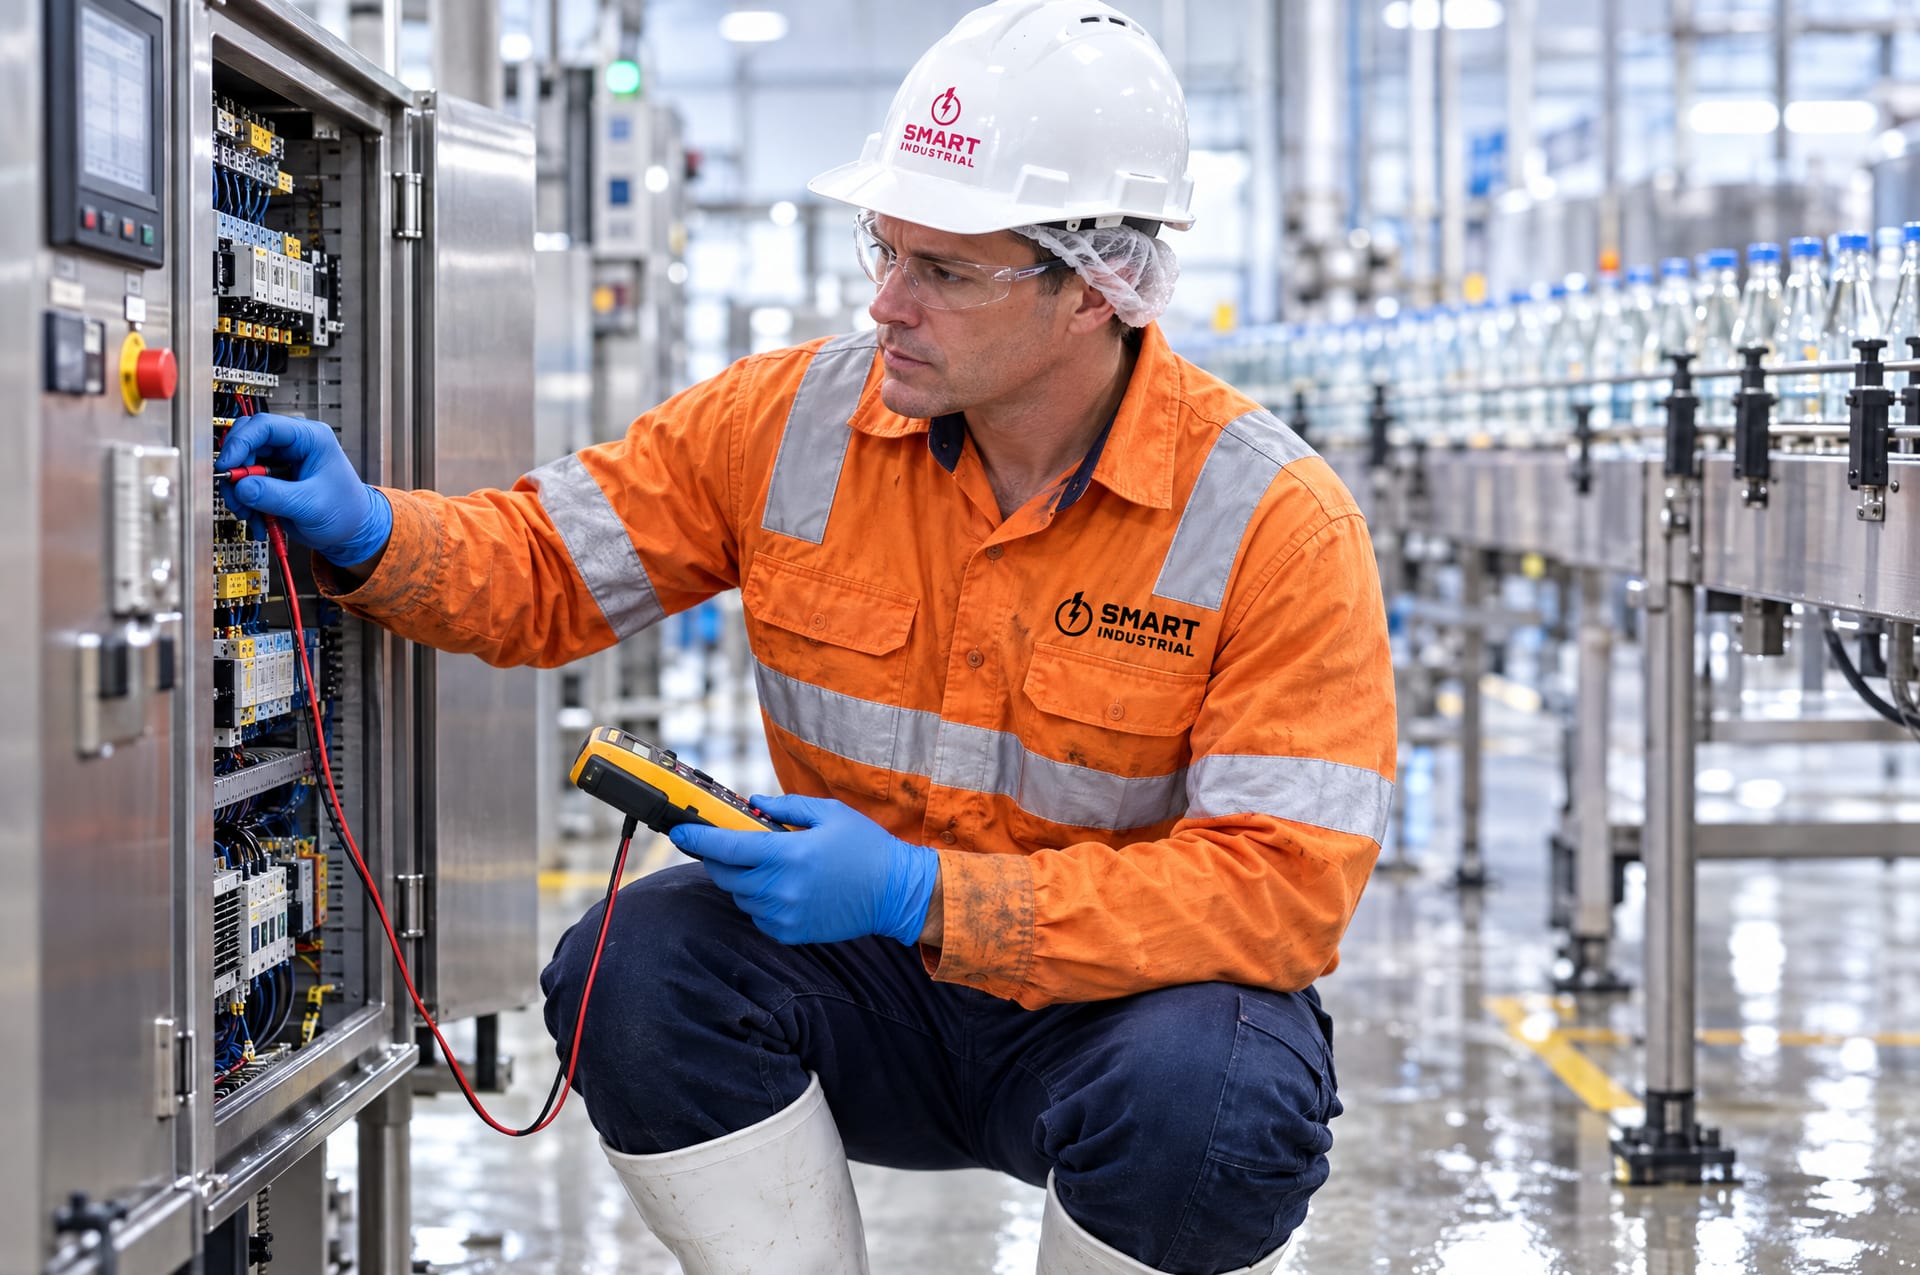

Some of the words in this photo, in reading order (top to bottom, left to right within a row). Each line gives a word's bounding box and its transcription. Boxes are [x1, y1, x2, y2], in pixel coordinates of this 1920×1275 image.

[900, 142, 974, 168] INDUSTRIAL
[904, 124, 981, 155] SMART
[1100, 603, 1200, 640] SMART
[1097, 626, 1194, 657] INDUSTRIAL
